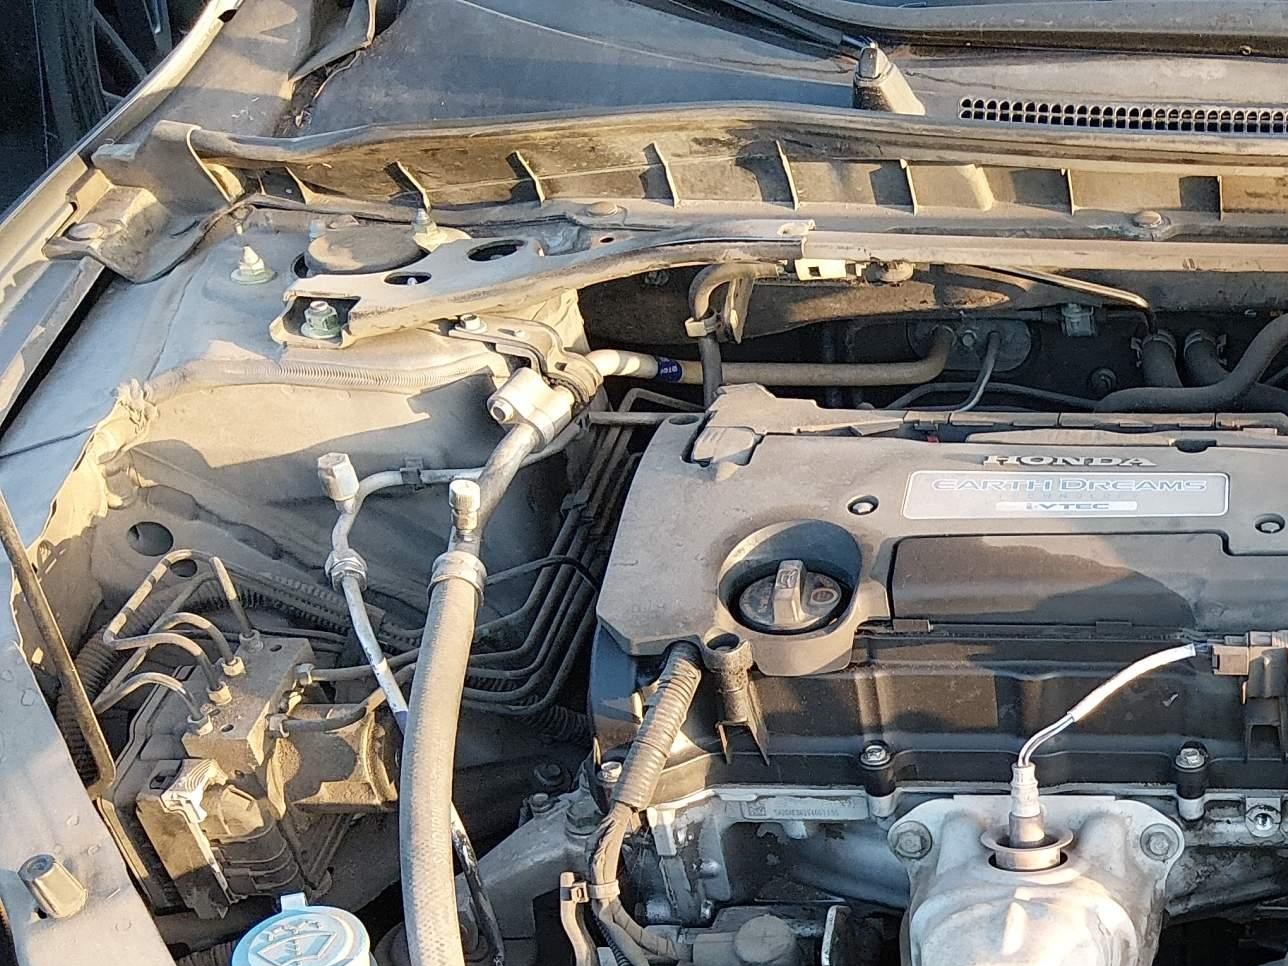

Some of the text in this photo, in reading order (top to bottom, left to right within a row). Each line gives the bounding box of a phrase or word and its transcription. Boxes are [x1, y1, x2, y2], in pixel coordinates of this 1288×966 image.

[982, 454, 1157, 467] HONDA
[931, 477, 1207, 492] EARTH DREAMS
